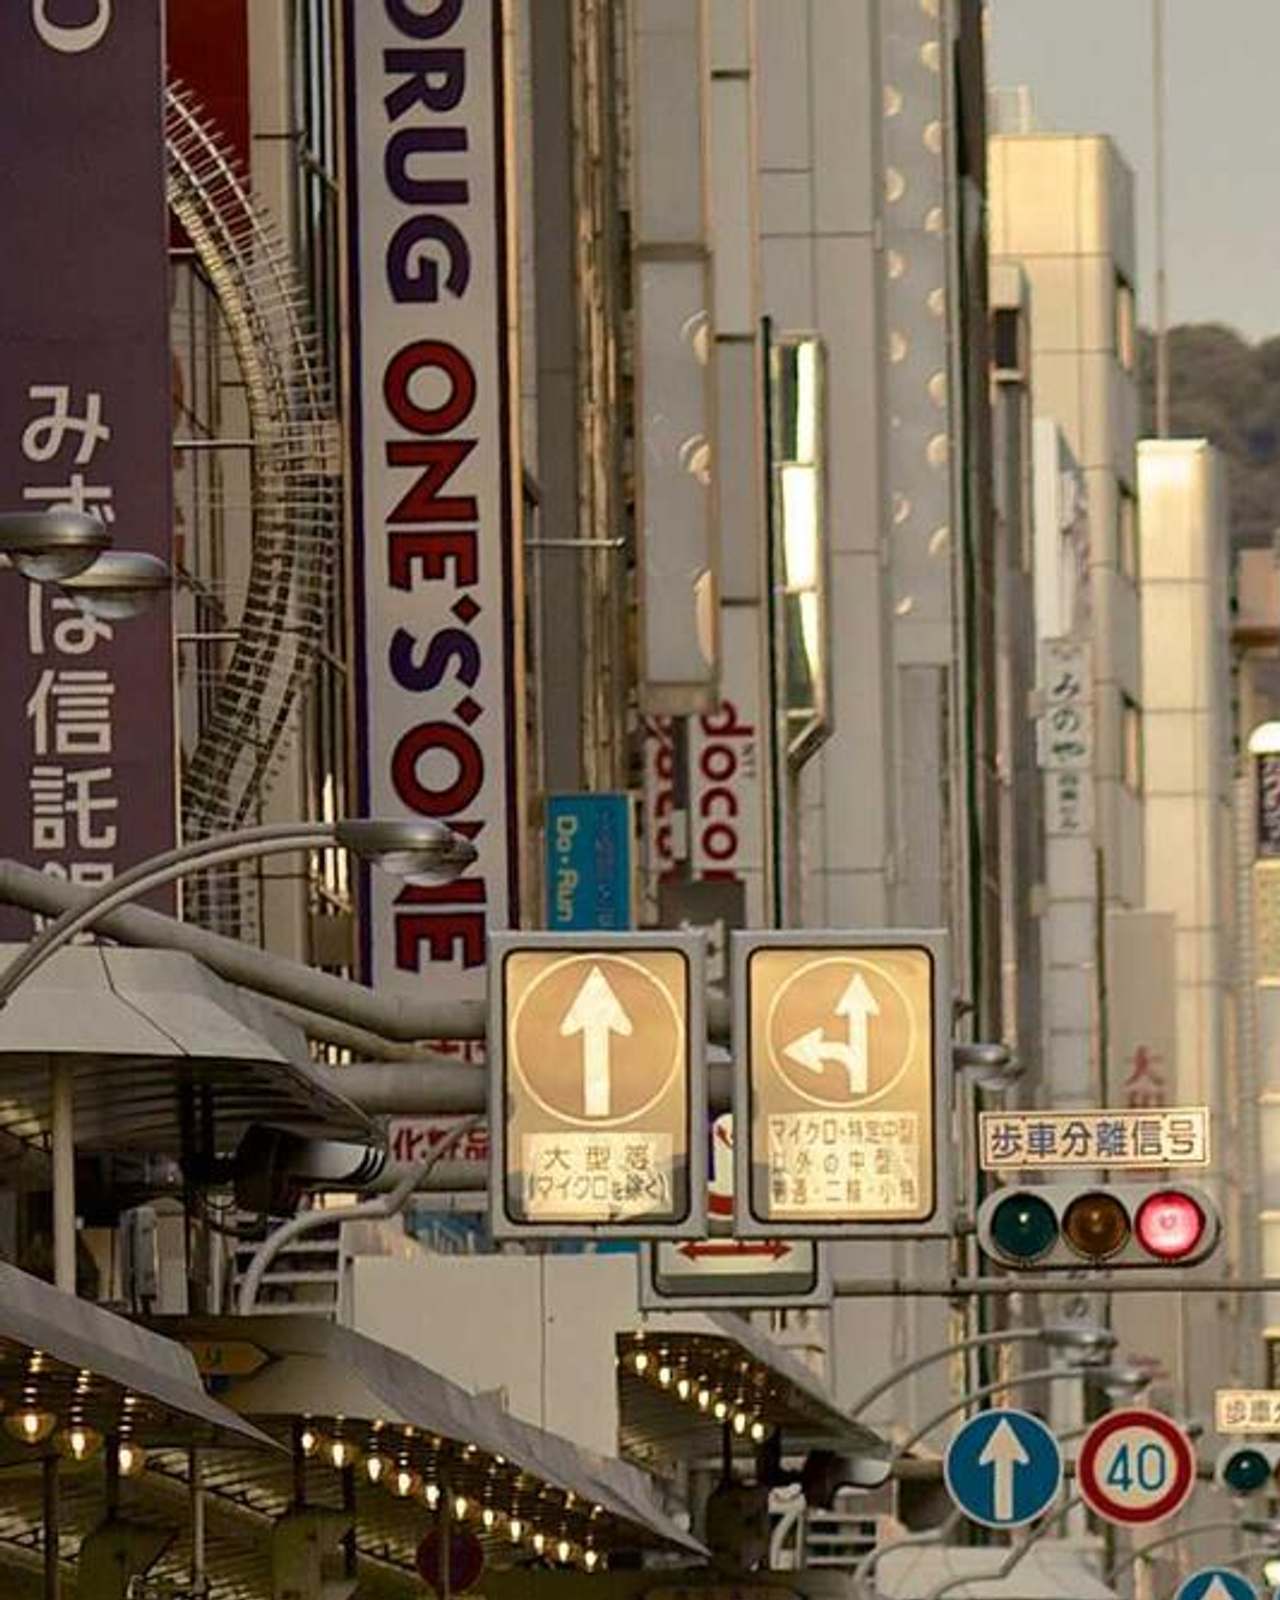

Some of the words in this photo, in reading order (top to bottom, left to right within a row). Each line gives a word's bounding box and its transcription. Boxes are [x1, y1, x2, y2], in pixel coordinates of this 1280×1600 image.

[702, 701, 754, 881] doco
[991, 1119, 1196, 1159] 歩車分離信号
[1106, 1443, 1169, 1492] 40
